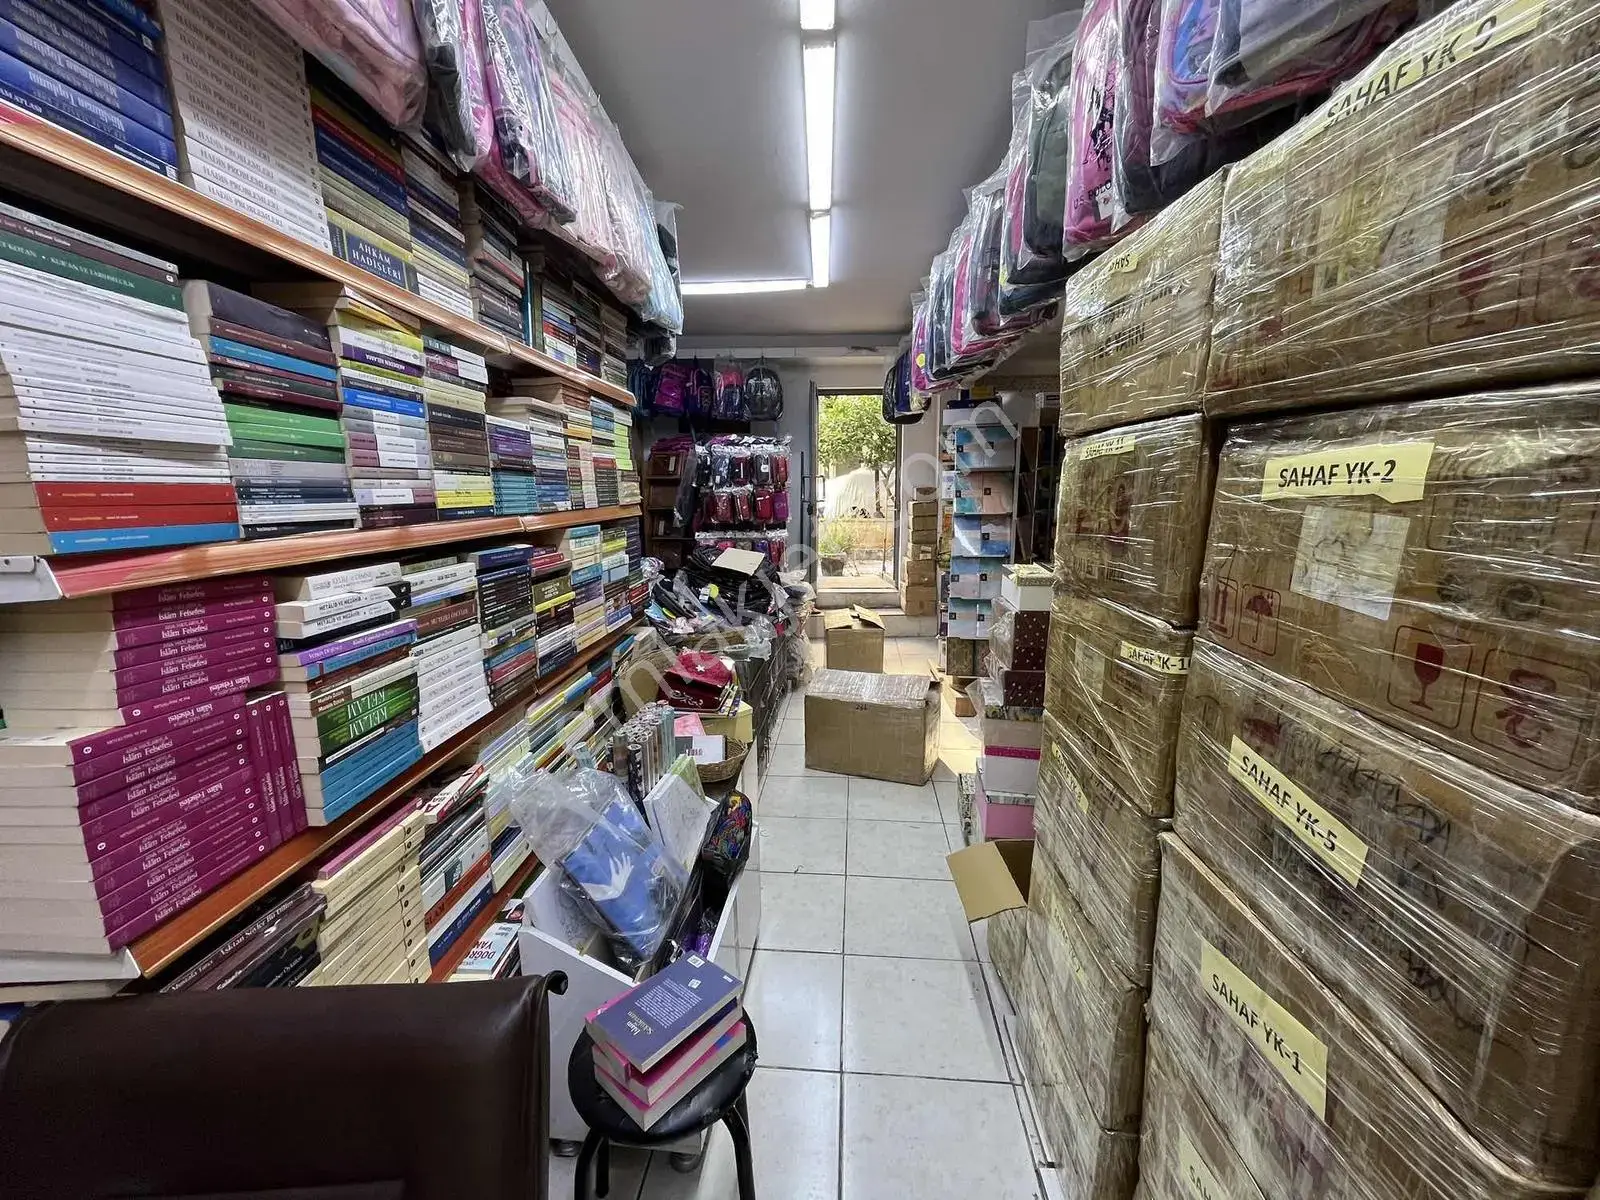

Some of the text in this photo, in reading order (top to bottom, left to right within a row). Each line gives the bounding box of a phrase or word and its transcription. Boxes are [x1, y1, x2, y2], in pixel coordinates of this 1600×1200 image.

[1326, 61, 1410, 126] SAHAF
[352, 249, 402, 280] HADİSLERİ
[1278, 459, 1397, 488] SAHAF YK-2
[179, 607, 206, 618] Felsefesi
[182, 624, 208, 635] Felsefesi
[180, 642, 207, 653] Felsefesi
[181, 659, 208, 670] Felsefesi
[182, 676, 209, 688] Felsefesi
[144, 739, 173, 756] Felsefesi
[147, 756, 176, 774] Felsefesi
[148, 773, 177, 792] Felsefesi
[152, 789, 180, 809] Felsefesi
[1240, 756, 1292, 808] SAHAF
[1296, 802, 1338, 852] YK-5
[160, 822, 187, 844] Felsefesi
[163, 839, 191, 860] Felsefesi
[168, 855, 195, 877] Felsefesi
[171, 871, 198, 893] Felsefesi
[465, 949, 495, 960] DOĞR
[1212, 974, 1301, 1075] SAHAF YK-1
